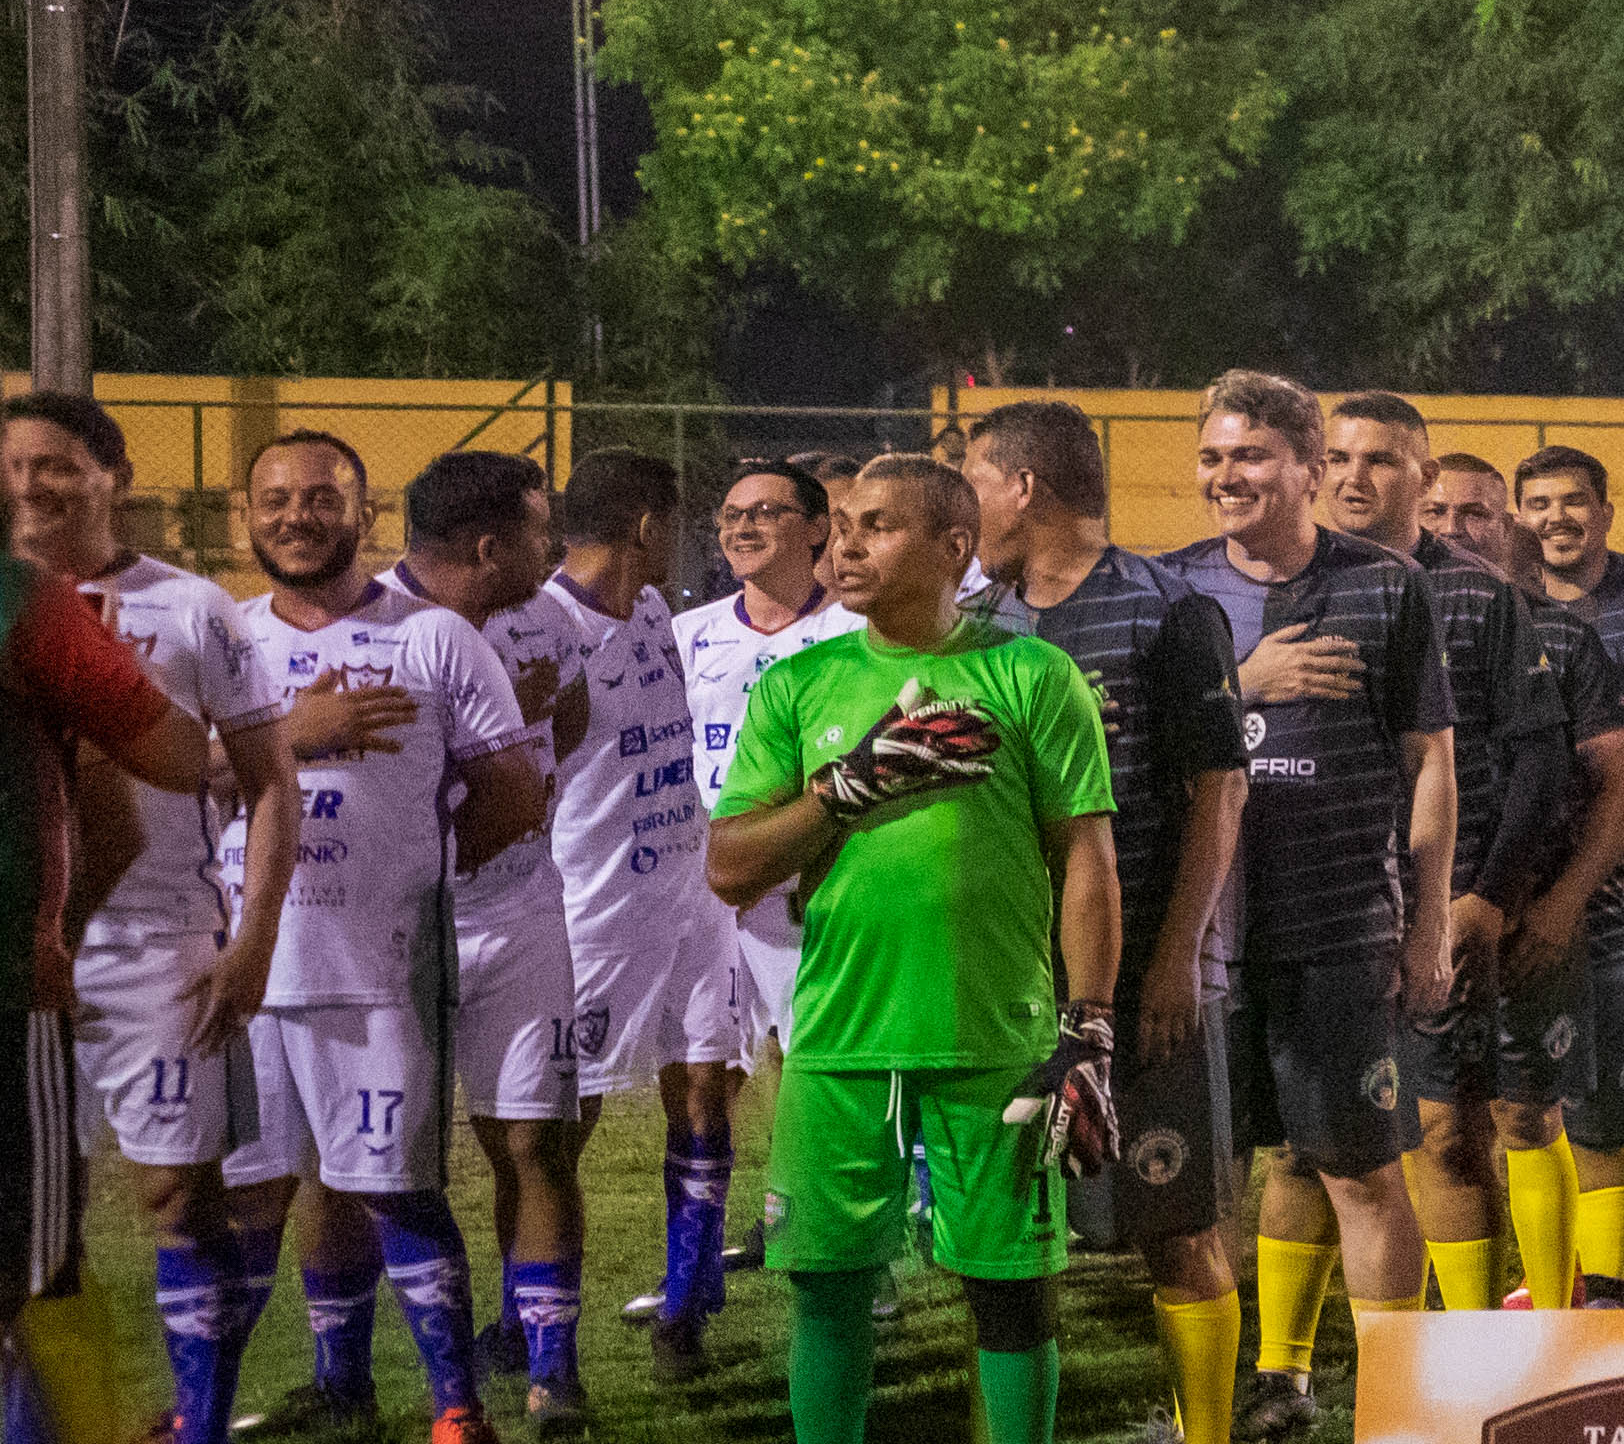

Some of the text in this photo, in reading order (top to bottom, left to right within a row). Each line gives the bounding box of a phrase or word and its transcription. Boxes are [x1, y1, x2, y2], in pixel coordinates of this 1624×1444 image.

[148, 1058, 190, 1104] 11
[356, 1089, 405, 1135] 17
[1033, 1170, 1053, 1223] 1
